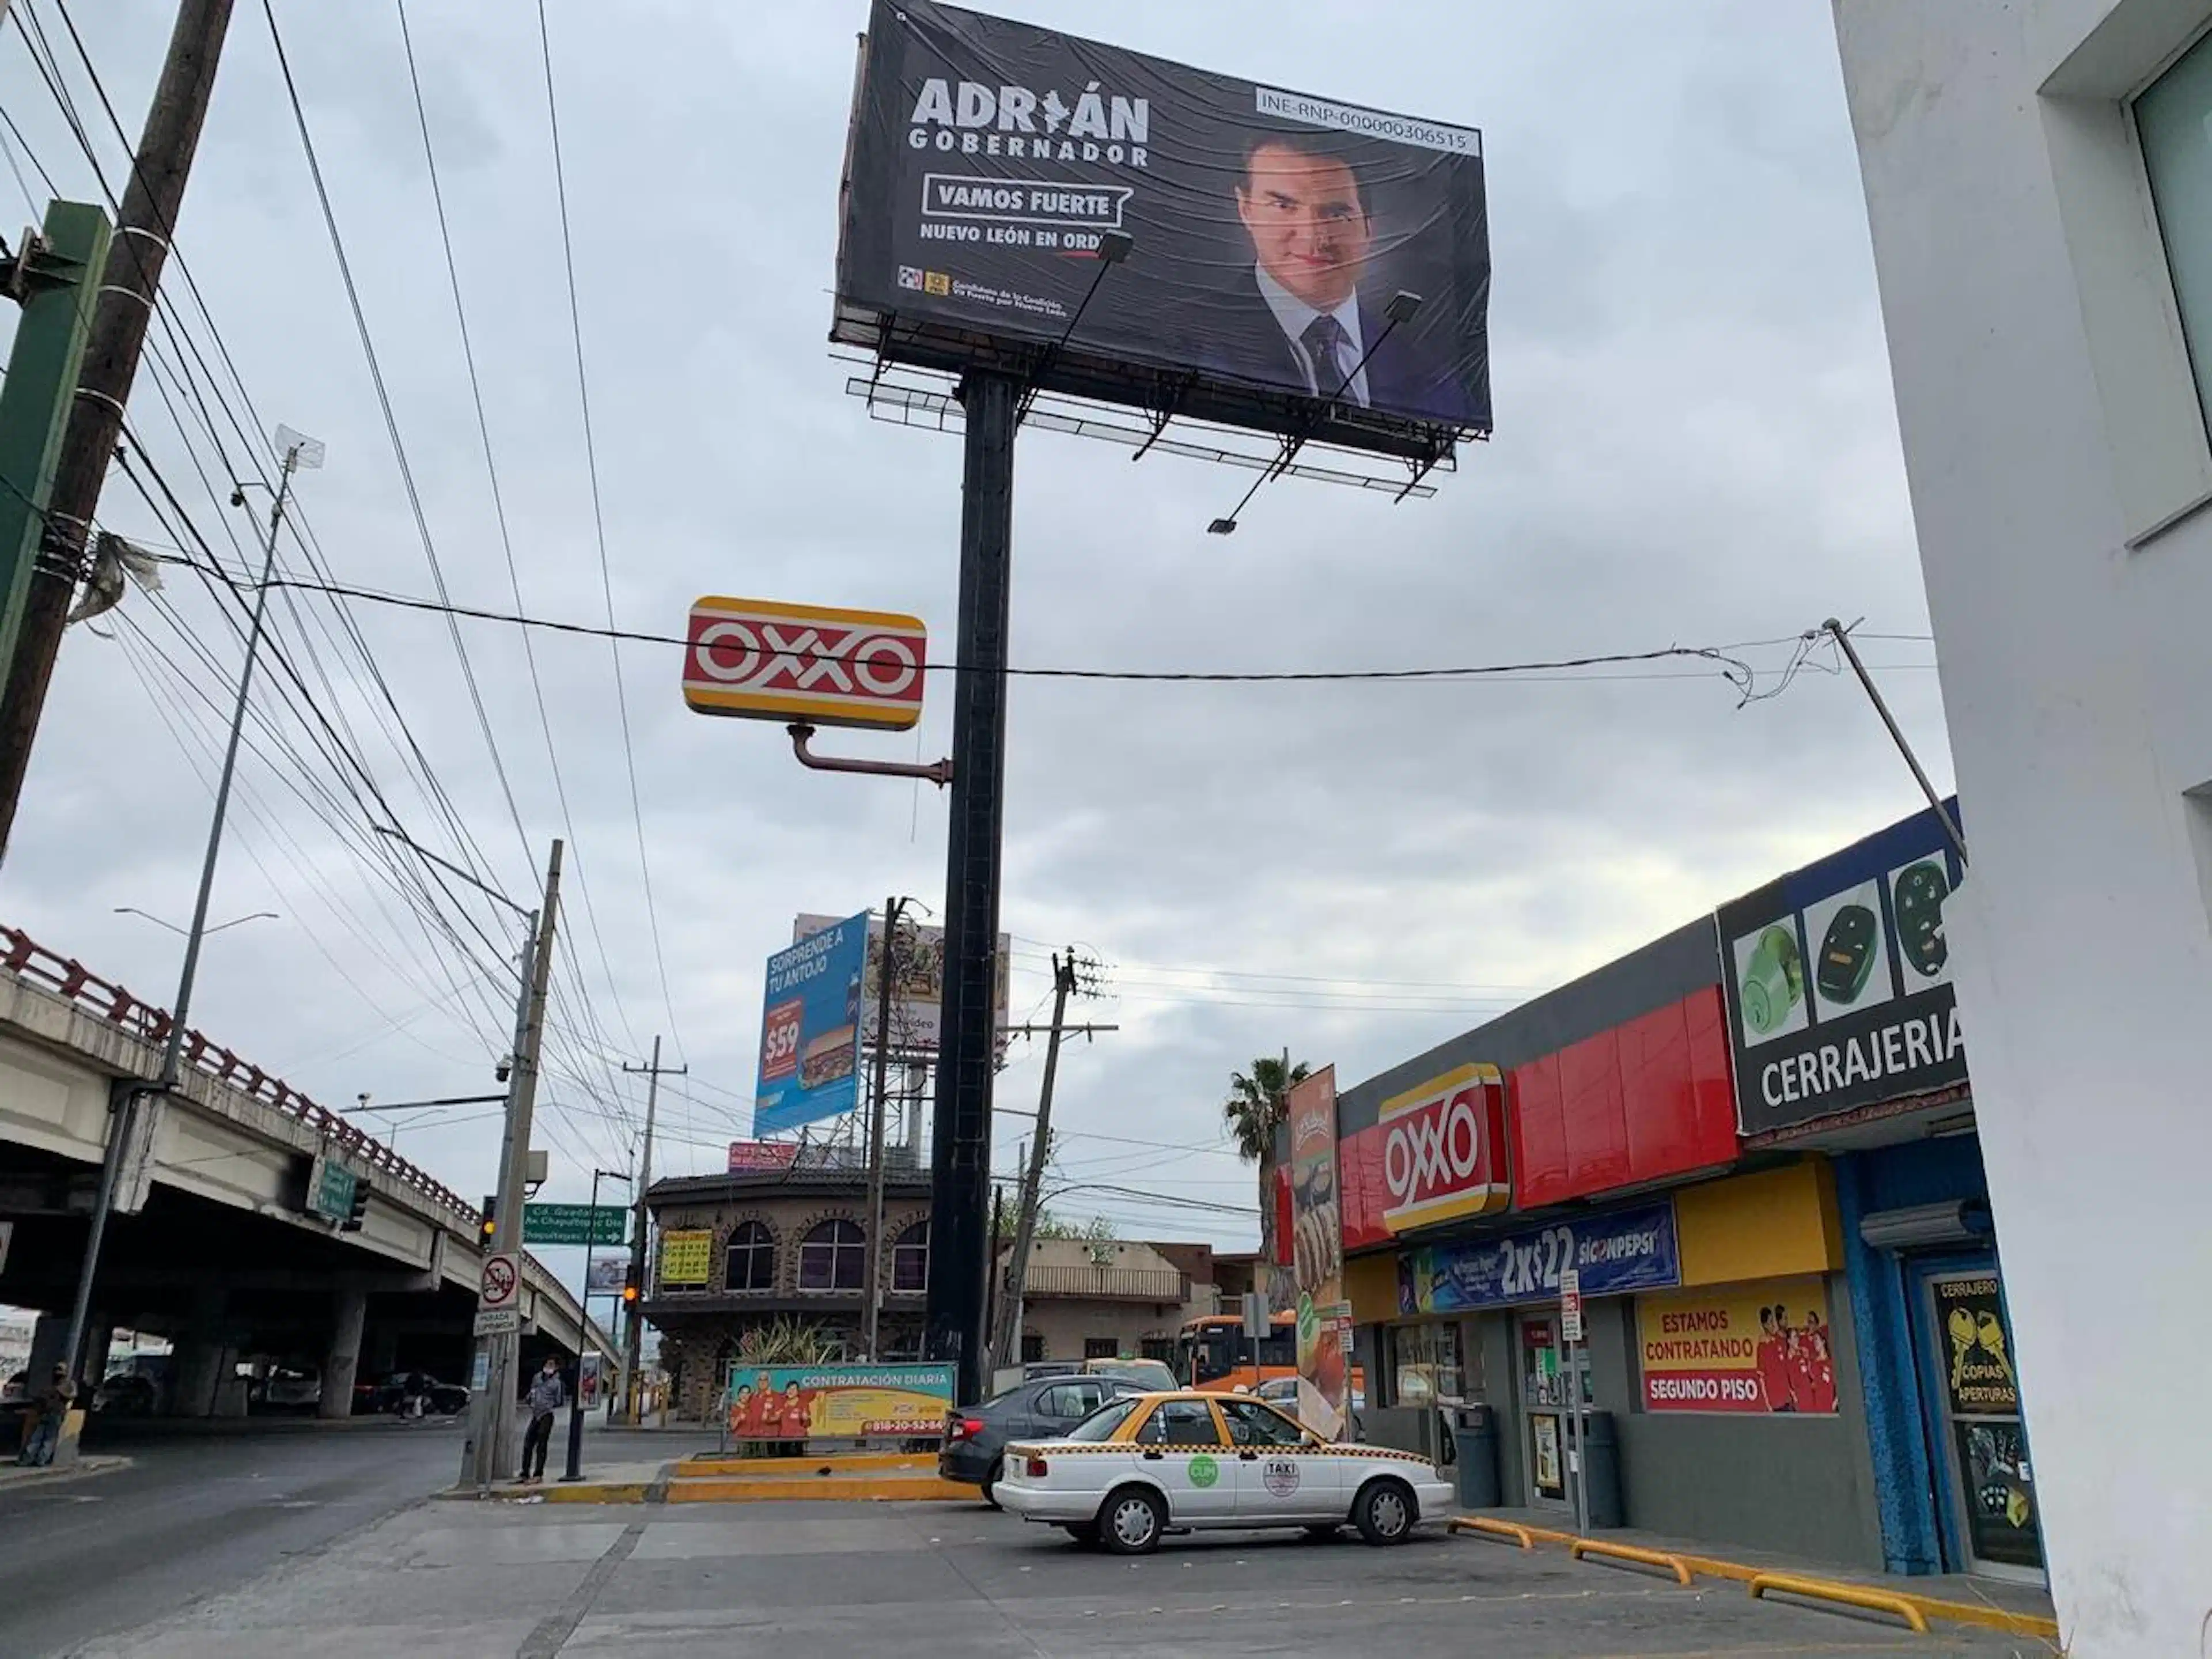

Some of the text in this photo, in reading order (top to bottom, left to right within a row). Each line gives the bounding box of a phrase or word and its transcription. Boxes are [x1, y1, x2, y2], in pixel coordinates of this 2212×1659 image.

[911, 79, 1149, 143] ADRIÁN
[908, 128, 1149, 167] GOBERNADOR
[938, 185, 1109, 215] VAMOS FUERTE
[921, 223, 1103, 250] NUEVO LEÓN EN ORD
[696, 622, 916, 695] OXXO
[771, 930, 834, 975] SORPRENDE
[769, 955, 827, 994] TU ANTOJO
[766, 1020, 800, 1066] $59
[1761, 1007, 1963, 1108] CERRAJERIA
[1385, 1094, 1477, 1206] OXXO
[1941, 1279, 1998, 1298] CERRAJERO
[1662, 1310, 1728, 1334] ESTAMOS
[1646, 1338, 1753, 1361] CONTRATANDO
[801, 1372, 902, 1387] CONTRATACIÓN
[1962, 1364, 2005, 1380] COPIAS
[1650, 1378, 1758, 1401] SEGUNDO PISO
[1958, 1387, 2016, 1402] APERTURAS
[1269, 1463, 1296, 1474] TAXI
